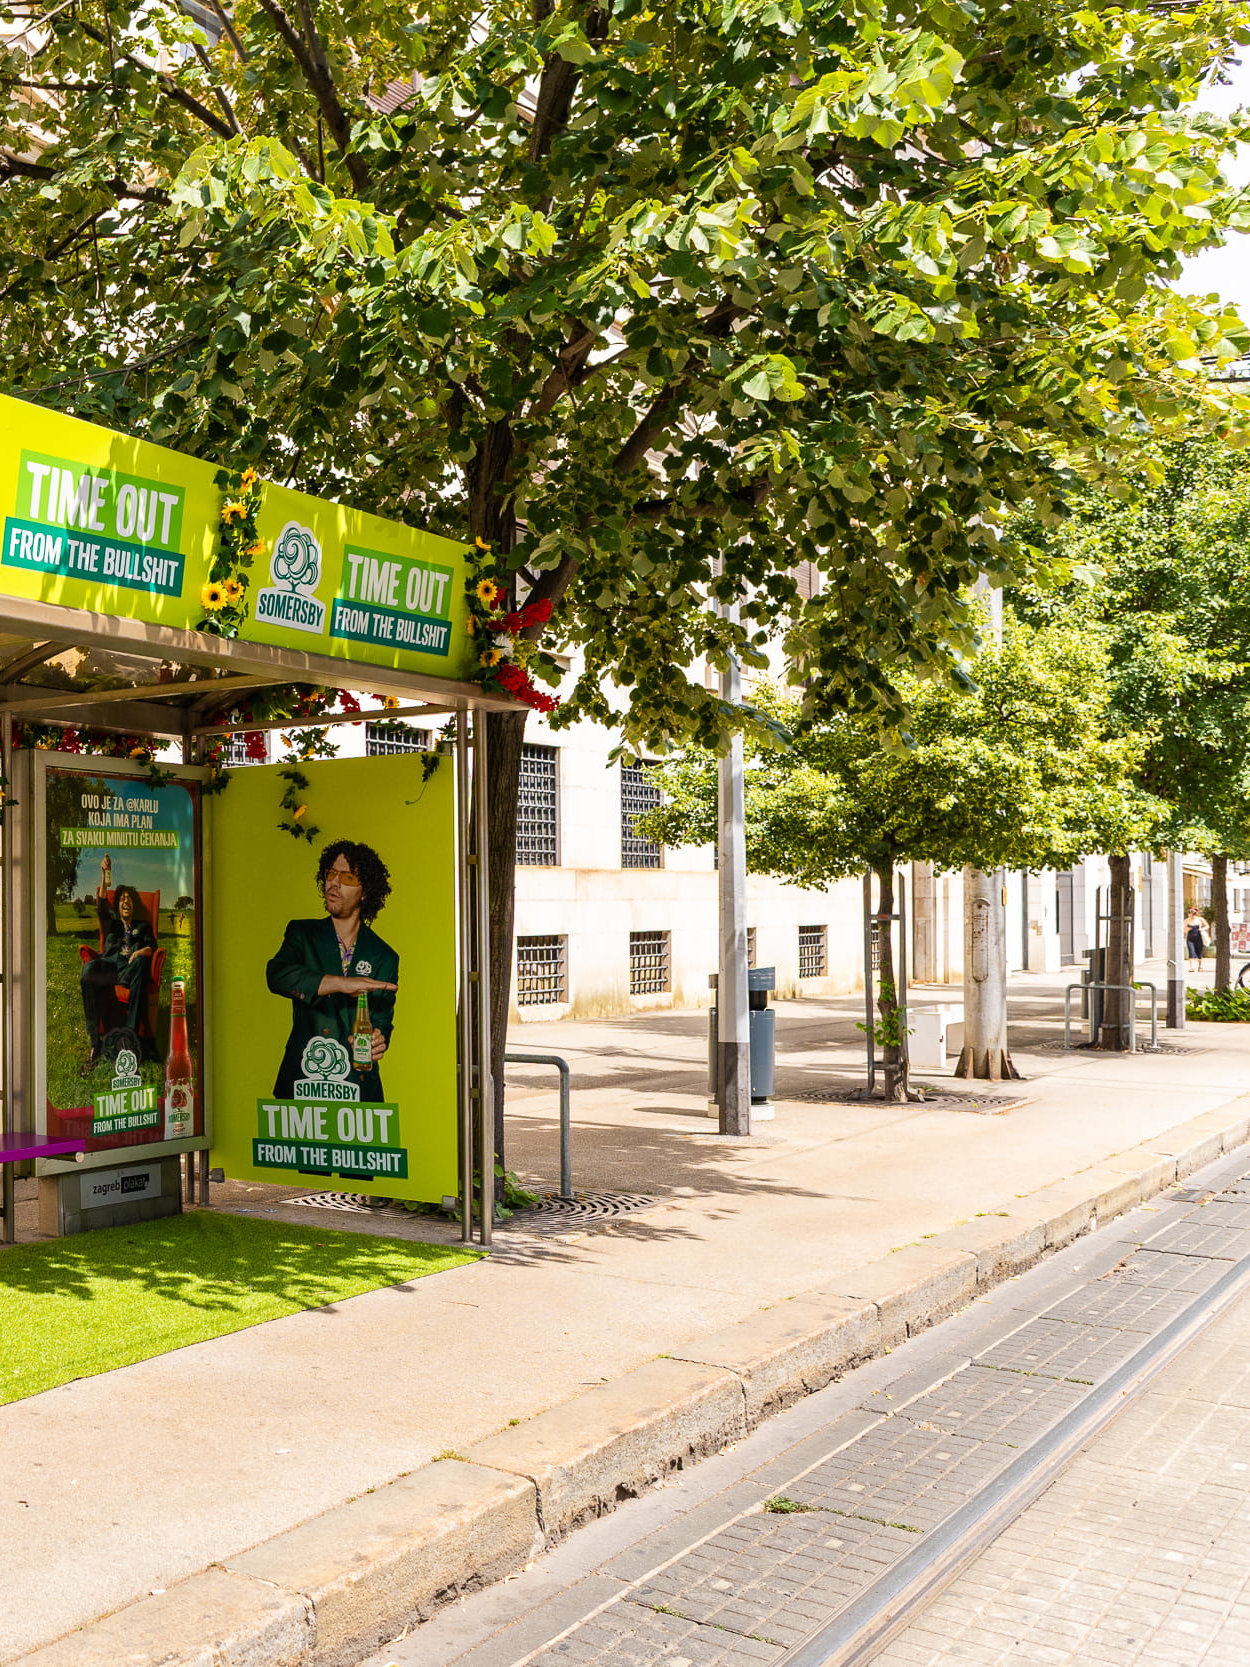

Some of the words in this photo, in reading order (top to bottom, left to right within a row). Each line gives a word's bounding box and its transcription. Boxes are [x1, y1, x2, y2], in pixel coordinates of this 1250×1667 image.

[26, 461, 109, 531] TIME
[115, 483, 179, 545] OUT
[9, 530, 63, 565] FROM
[67, 540, 99, 573] THE
[103, 548, 179, 588] BULLSHIT
[348, 554, 399, 607] TIME
[406, 569, 449, 615] OUT
[258, 594, 323, 628] SOMERSBY
[334, 613, 369, 640] FROM
[372, 617, 395, 643] THE
[398, 621, 448, 650] BULLSHIT
[81, 794, 99, 809] OVO
[101, 796, 111, 810] JE
[113, 796, 124, 811] ZA
[126, 798, 159, 814] @KARLU
[88, 812, 111, 827] KOJA
[113, 813, 130, 828] IMA
[132, 815, 153, 829] PLAN
[62, 831, 74, 845] ZA
[76, 831, 104, 846] SVAKU
[107, 831, 138, 847] MINUTU
[141, 829, 177, 847] ČEKANJA
[113, 1077, 141, 1089] SOMERSBY
[296, 1082, 358, 1101] SOMERSBY
[97, 1093, 128, 1117] TIME
[131, 1088, 155, 1111] OUT
[94, 1120, 112, 1134] FROM
[114, 1118, 127, 1130] THE
[128, 1112, 158, 1128] BULLSHIT
[262, 1105, 329, 1140] TIME
[337, 1107, 393, 1144] OUT
[258, 1144, 296, 1164] FROM
[300, 1147, 328, 1167] THE
[332, 1150, 402, 1172] BULLSHIT
[93, 1179, 120, 1196] zagreb
